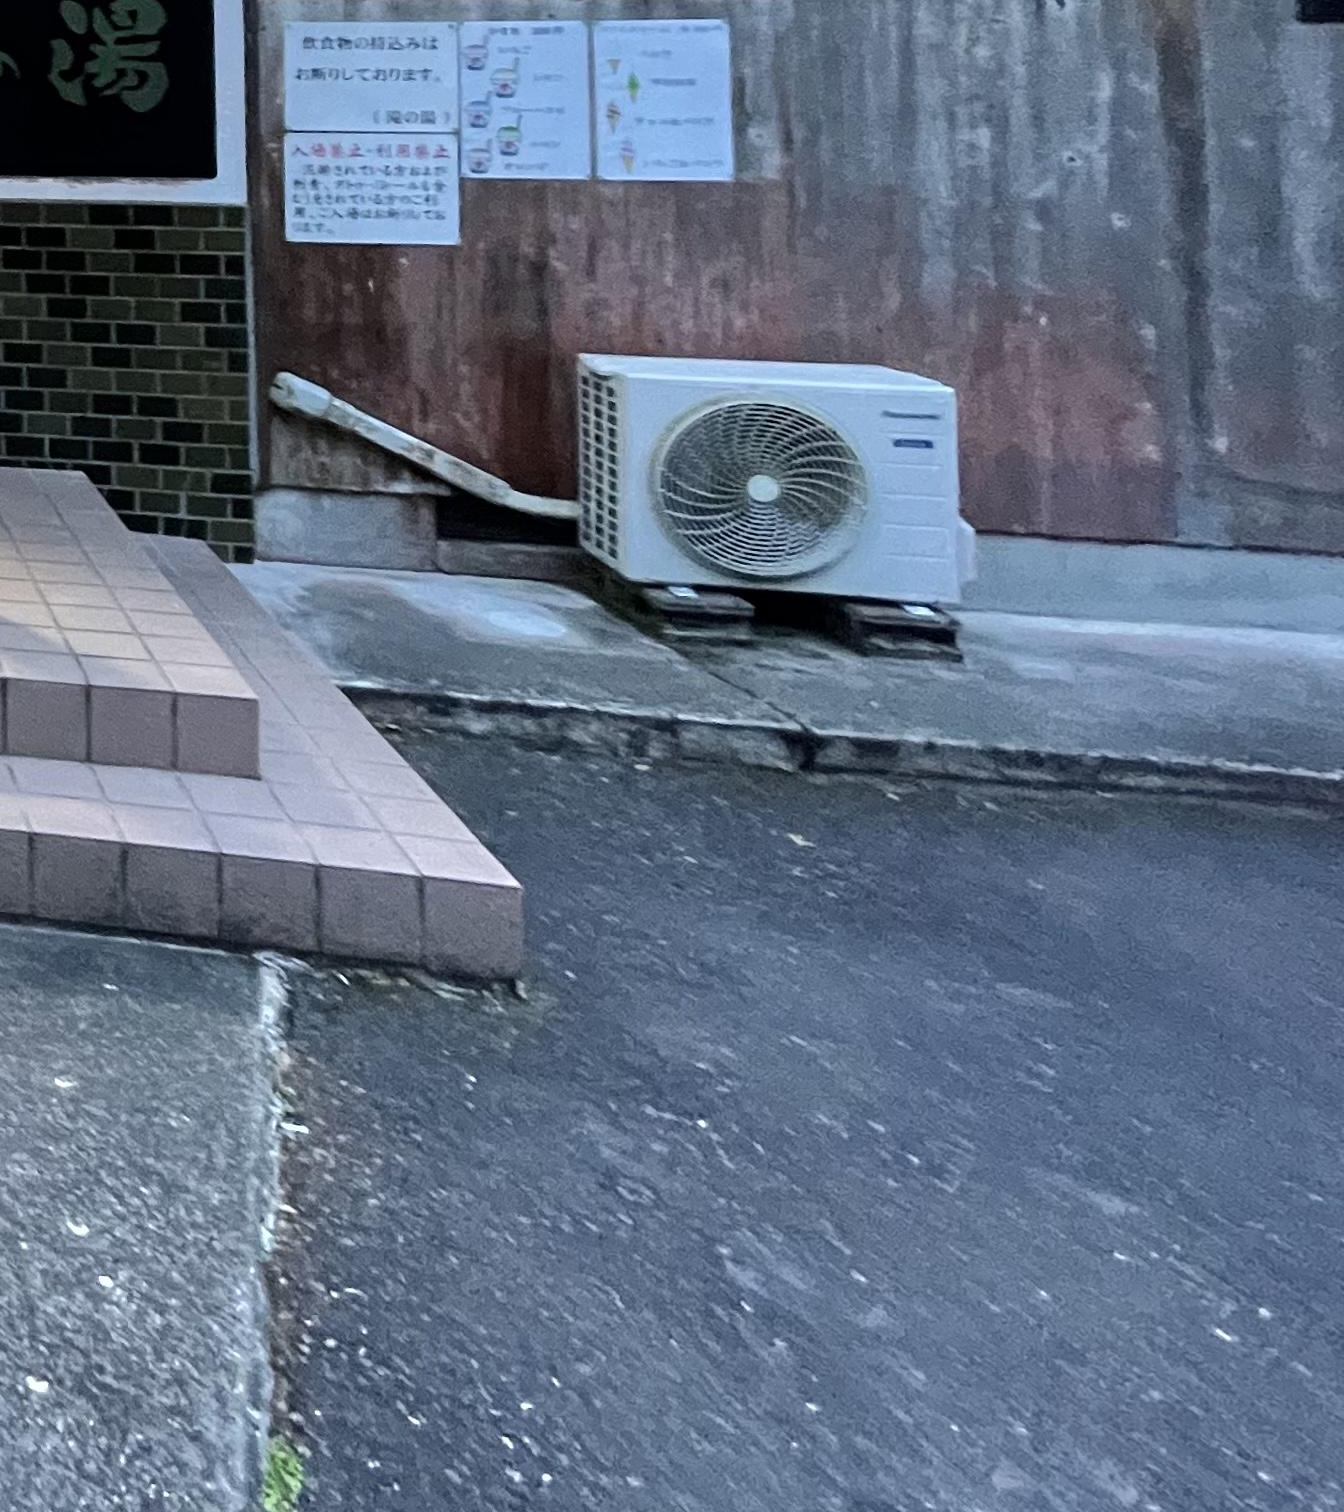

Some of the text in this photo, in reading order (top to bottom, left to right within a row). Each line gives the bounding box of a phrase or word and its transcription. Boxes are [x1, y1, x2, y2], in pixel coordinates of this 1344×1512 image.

[295, 67, 442, 82] お断りしております。
